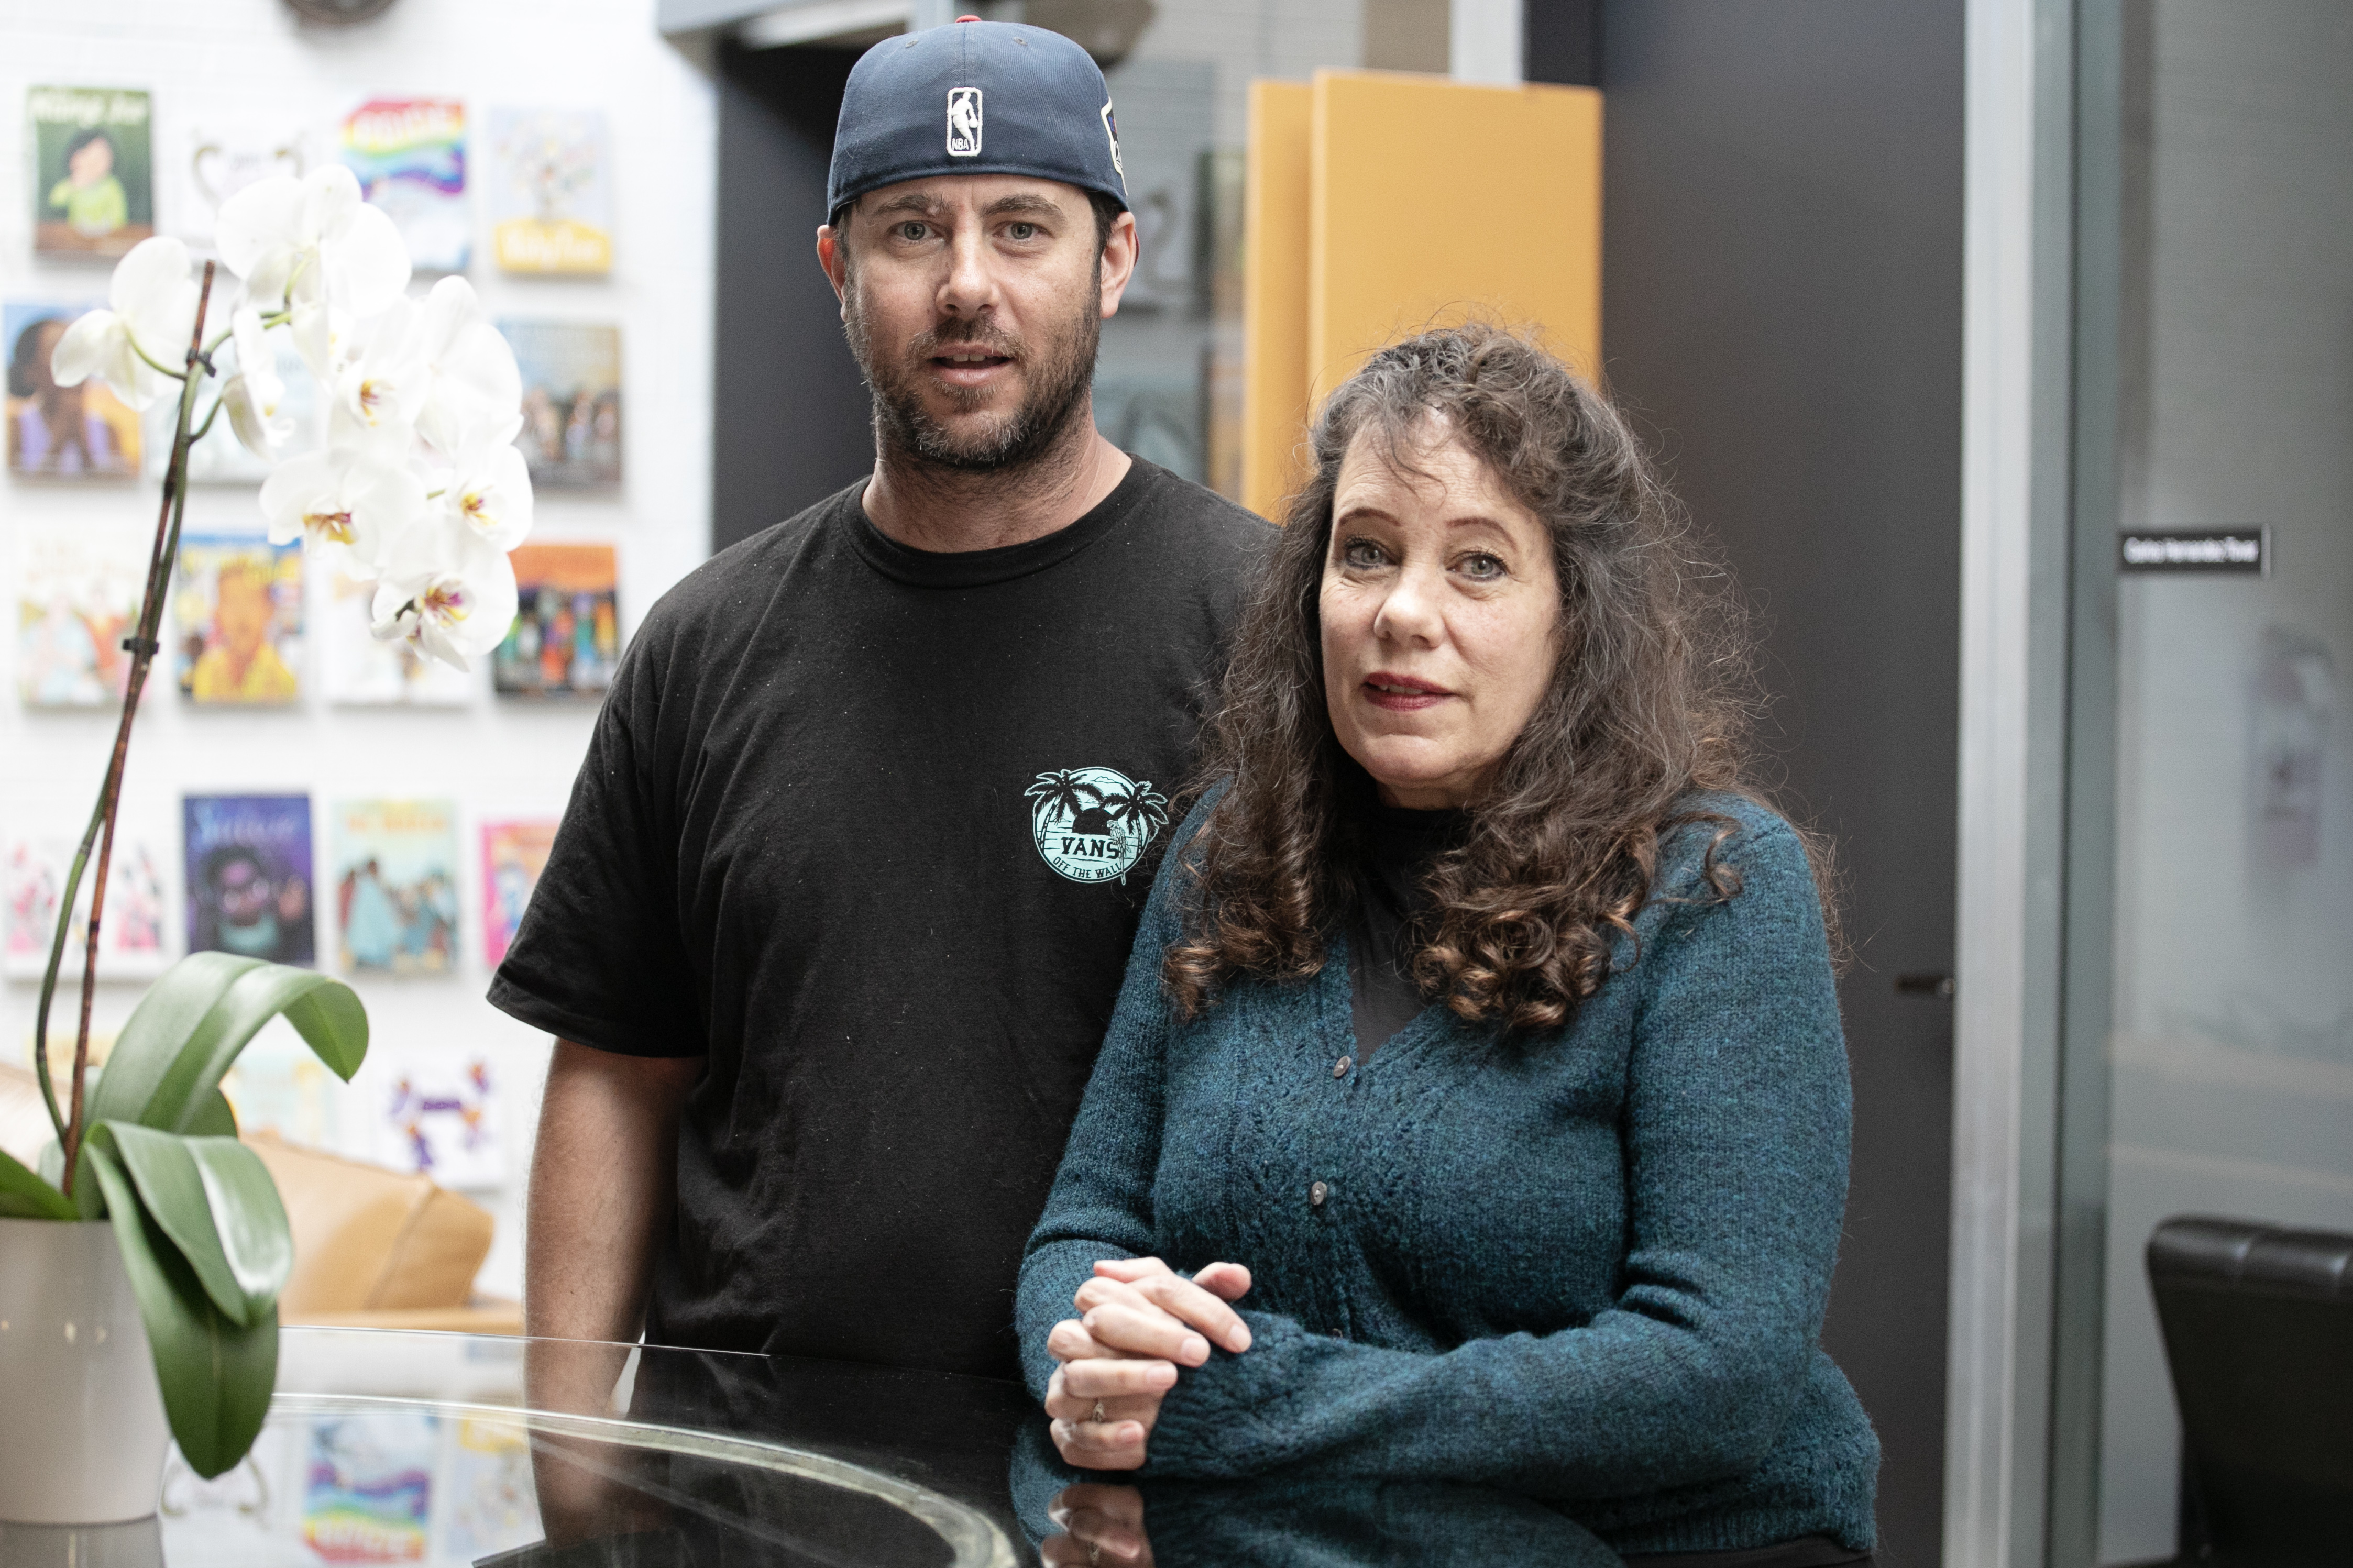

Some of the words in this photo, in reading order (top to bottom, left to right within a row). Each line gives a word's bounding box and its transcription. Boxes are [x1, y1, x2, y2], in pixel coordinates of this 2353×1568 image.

[952, 138, 969, 150] NBA
[1061, 836, 1120, 859] VANS
[1053, 856, 1071, 871] OFF
[1072, 867, 1092, 878] THE
[1095, 863, 1121, 878] WALL
